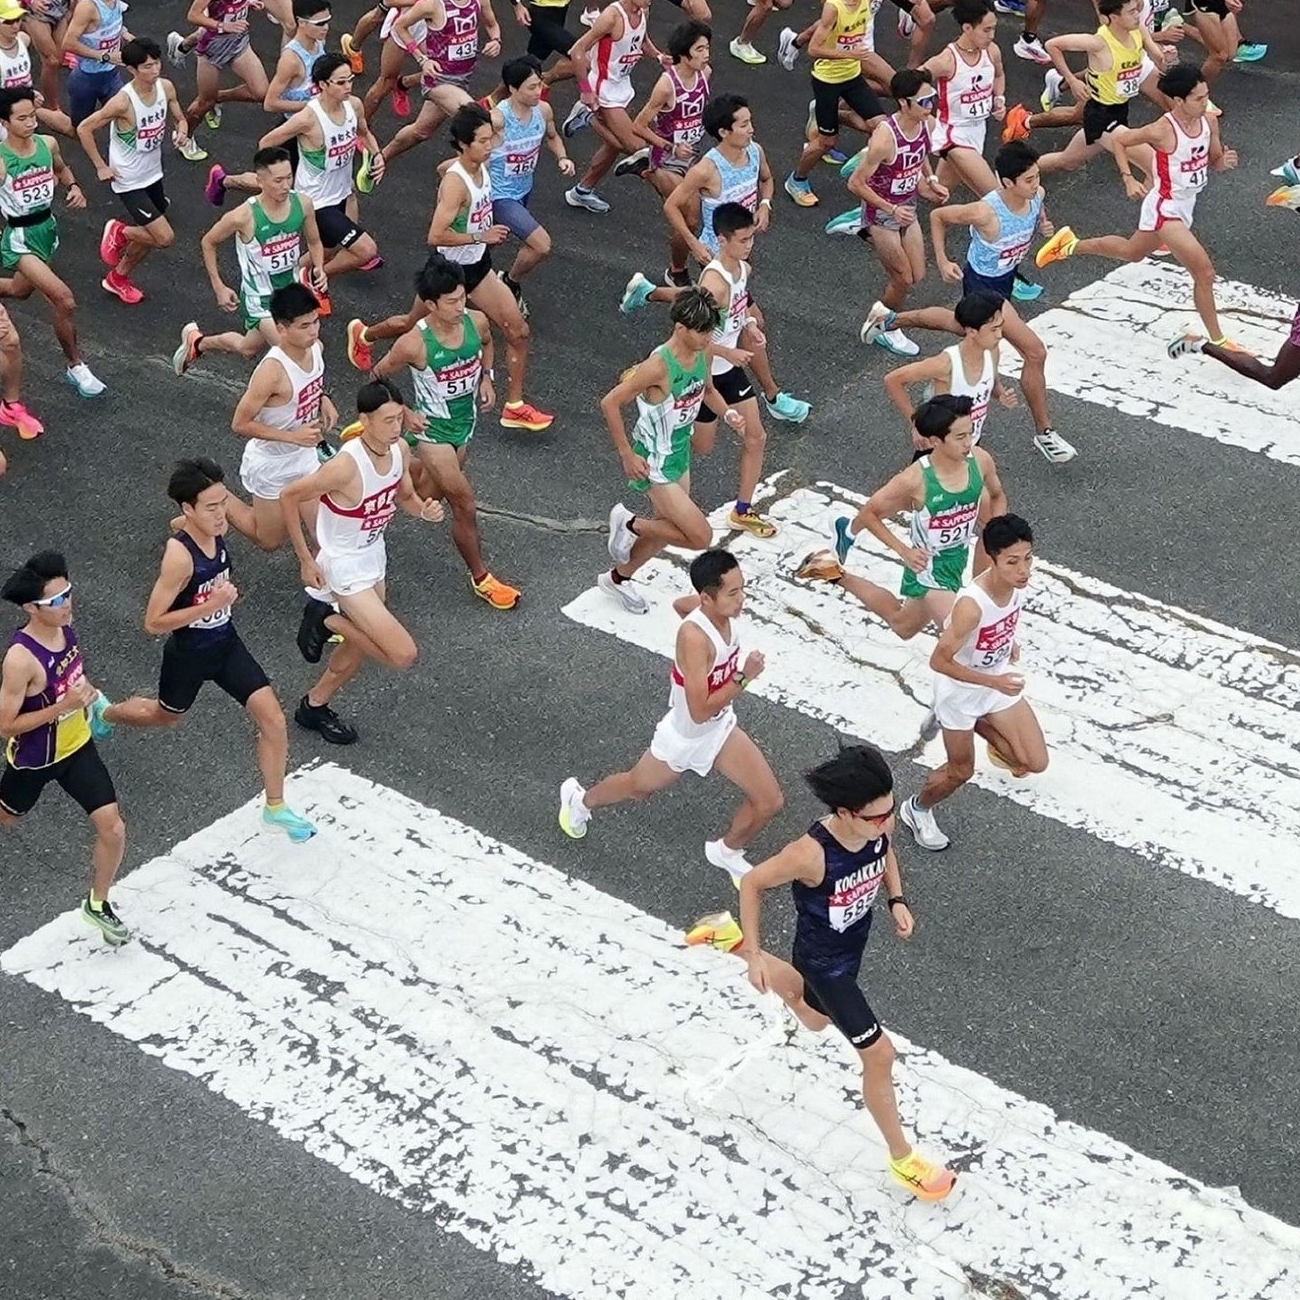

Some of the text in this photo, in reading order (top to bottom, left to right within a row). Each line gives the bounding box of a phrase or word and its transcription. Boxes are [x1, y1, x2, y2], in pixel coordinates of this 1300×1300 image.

[22, 184, 51, 203] 523
[941, 508, 977, 527] SAPPORO
[940, 522, 971, 545] 521
[835, 855, 887, 894] KOGAKKAN
[843, 891, 876, 923] 585
